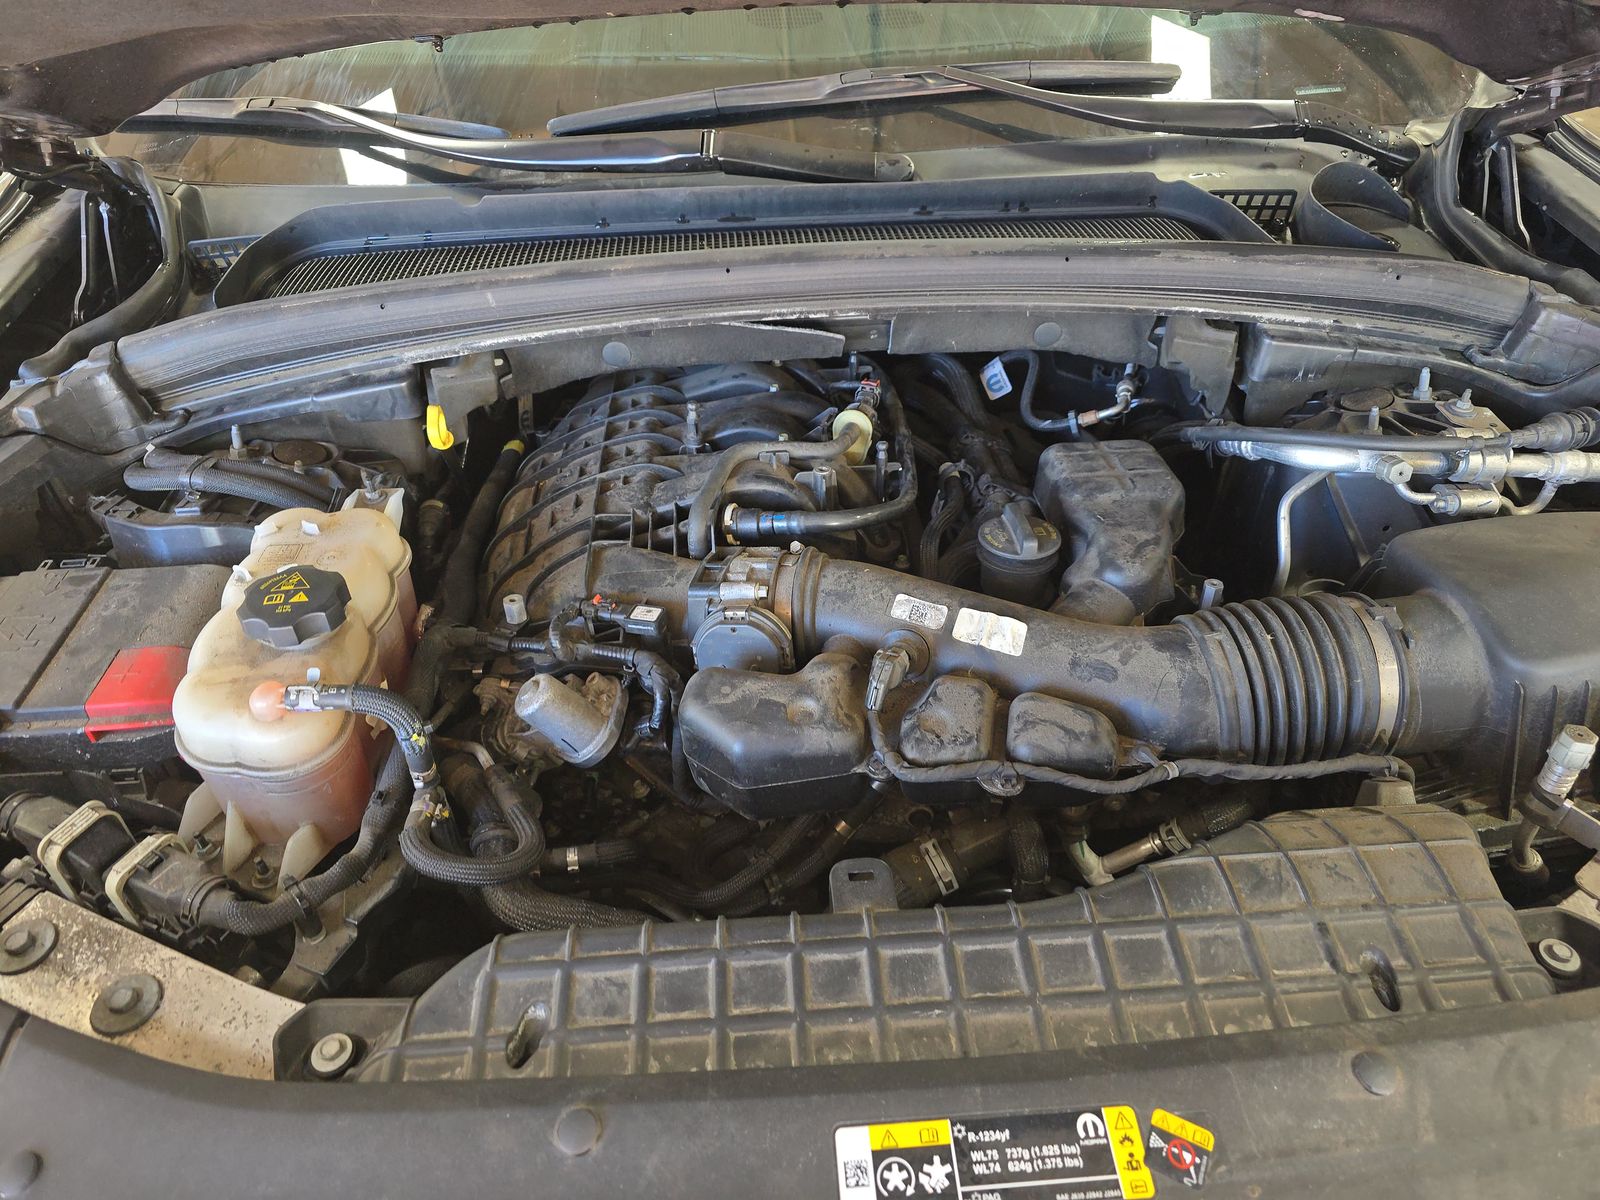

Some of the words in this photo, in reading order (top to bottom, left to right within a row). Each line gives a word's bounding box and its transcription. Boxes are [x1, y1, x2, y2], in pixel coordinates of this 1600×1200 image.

[967, 1129, 1010, 1143] R-1234yf
[1005, 1147, 1030, 1160] 737g
[1061, 1142, 1080, 1155] lbs)
[972, 1162, 1001, 1175] WL74
[1064, 1156, 1083, 1169] lbs)
